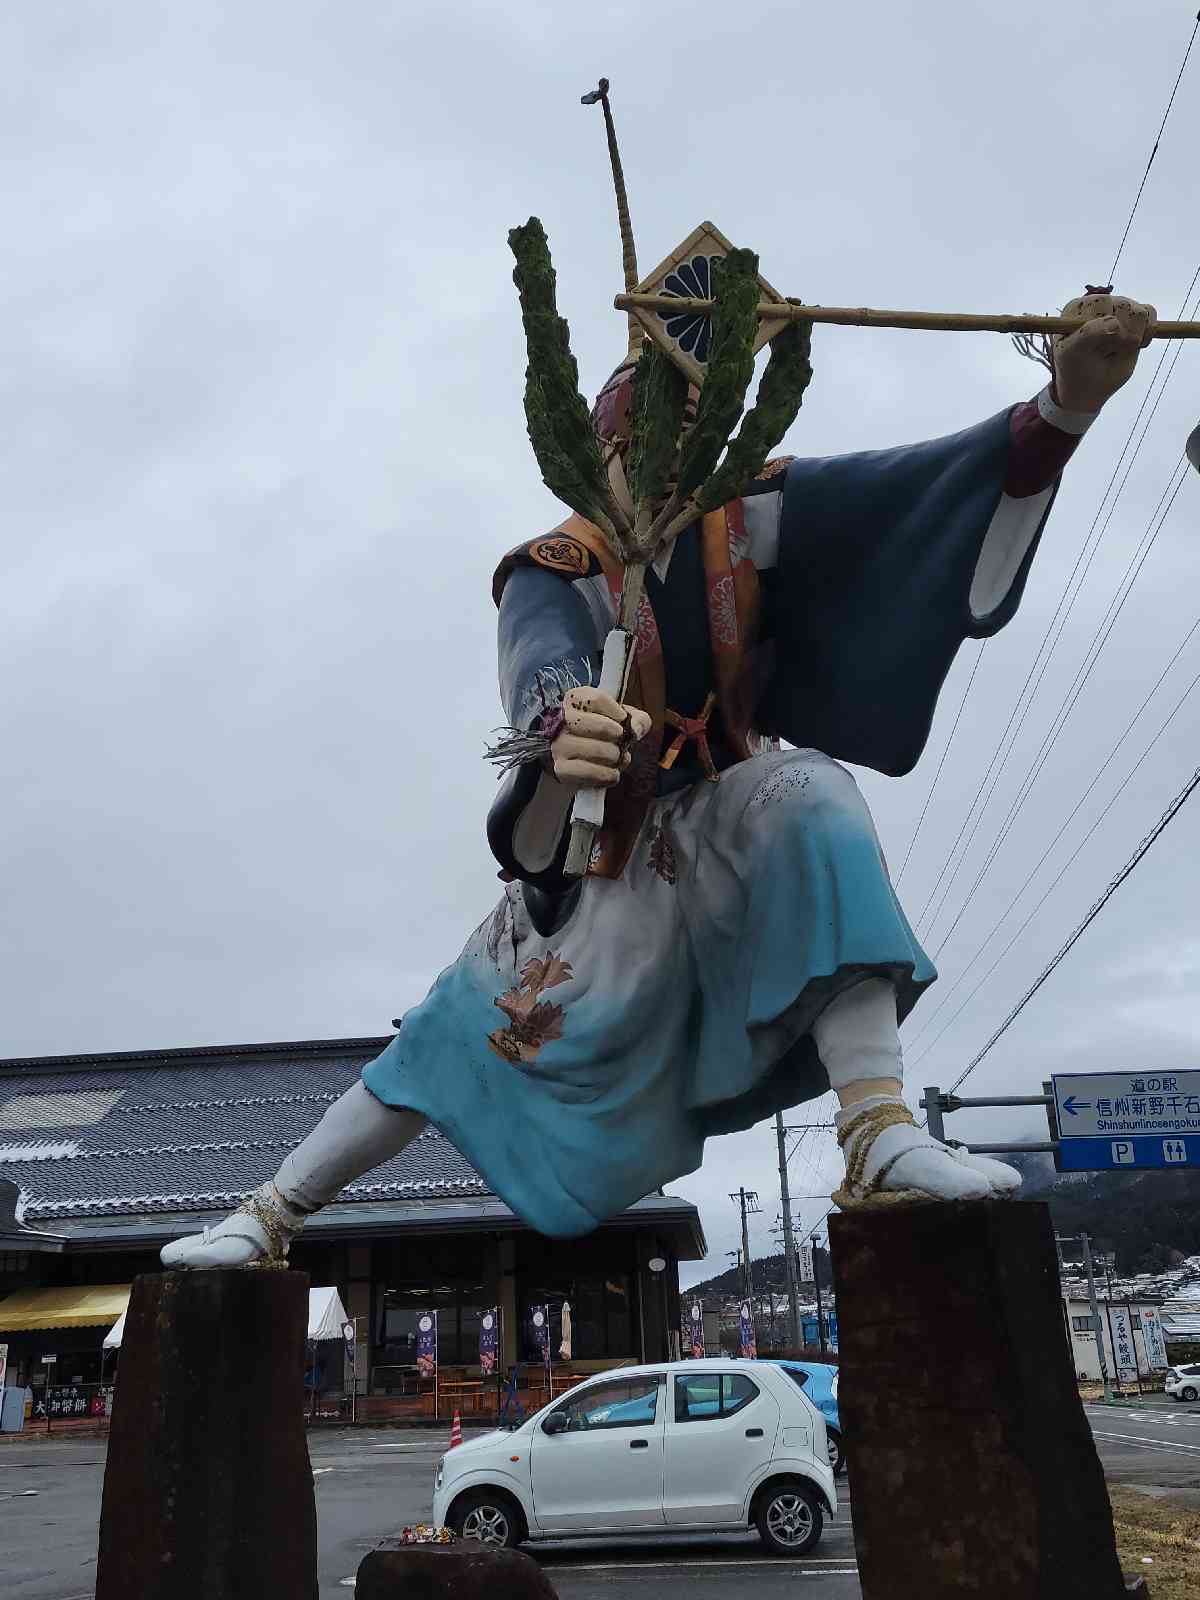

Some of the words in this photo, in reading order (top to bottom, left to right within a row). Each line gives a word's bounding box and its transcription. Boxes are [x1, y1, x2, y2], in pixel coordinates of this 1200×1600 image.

[1130, 1077, 1178, 1093] 道の駅
[1096, 1095, 1200, 1117] 信州新野千石
[1115, 1143, 1129, 1163] P
